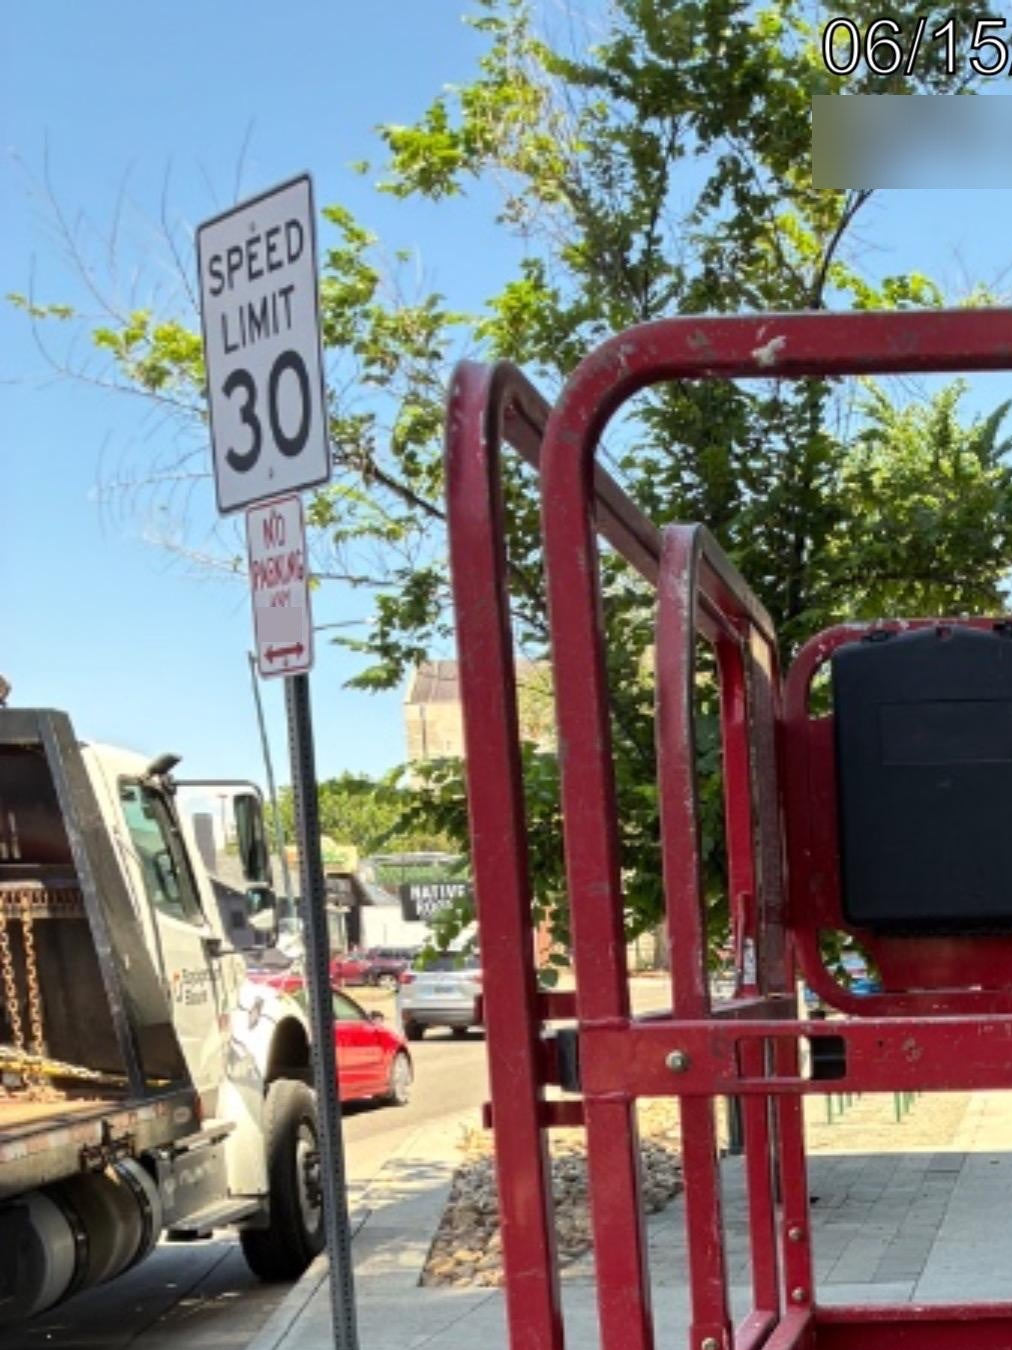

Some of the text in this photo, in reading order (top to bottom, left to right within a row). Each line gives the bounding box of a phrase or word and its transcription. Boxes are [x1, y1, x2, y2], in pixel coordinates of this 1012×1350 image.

[208, 217, 305, 297] SPEED
[220, 284, 295, 354] LIMIT
[221, 349, 313, 473] 30
[262, 514, 285, 548] NO
[253, 549, 305, 590] PARKING
